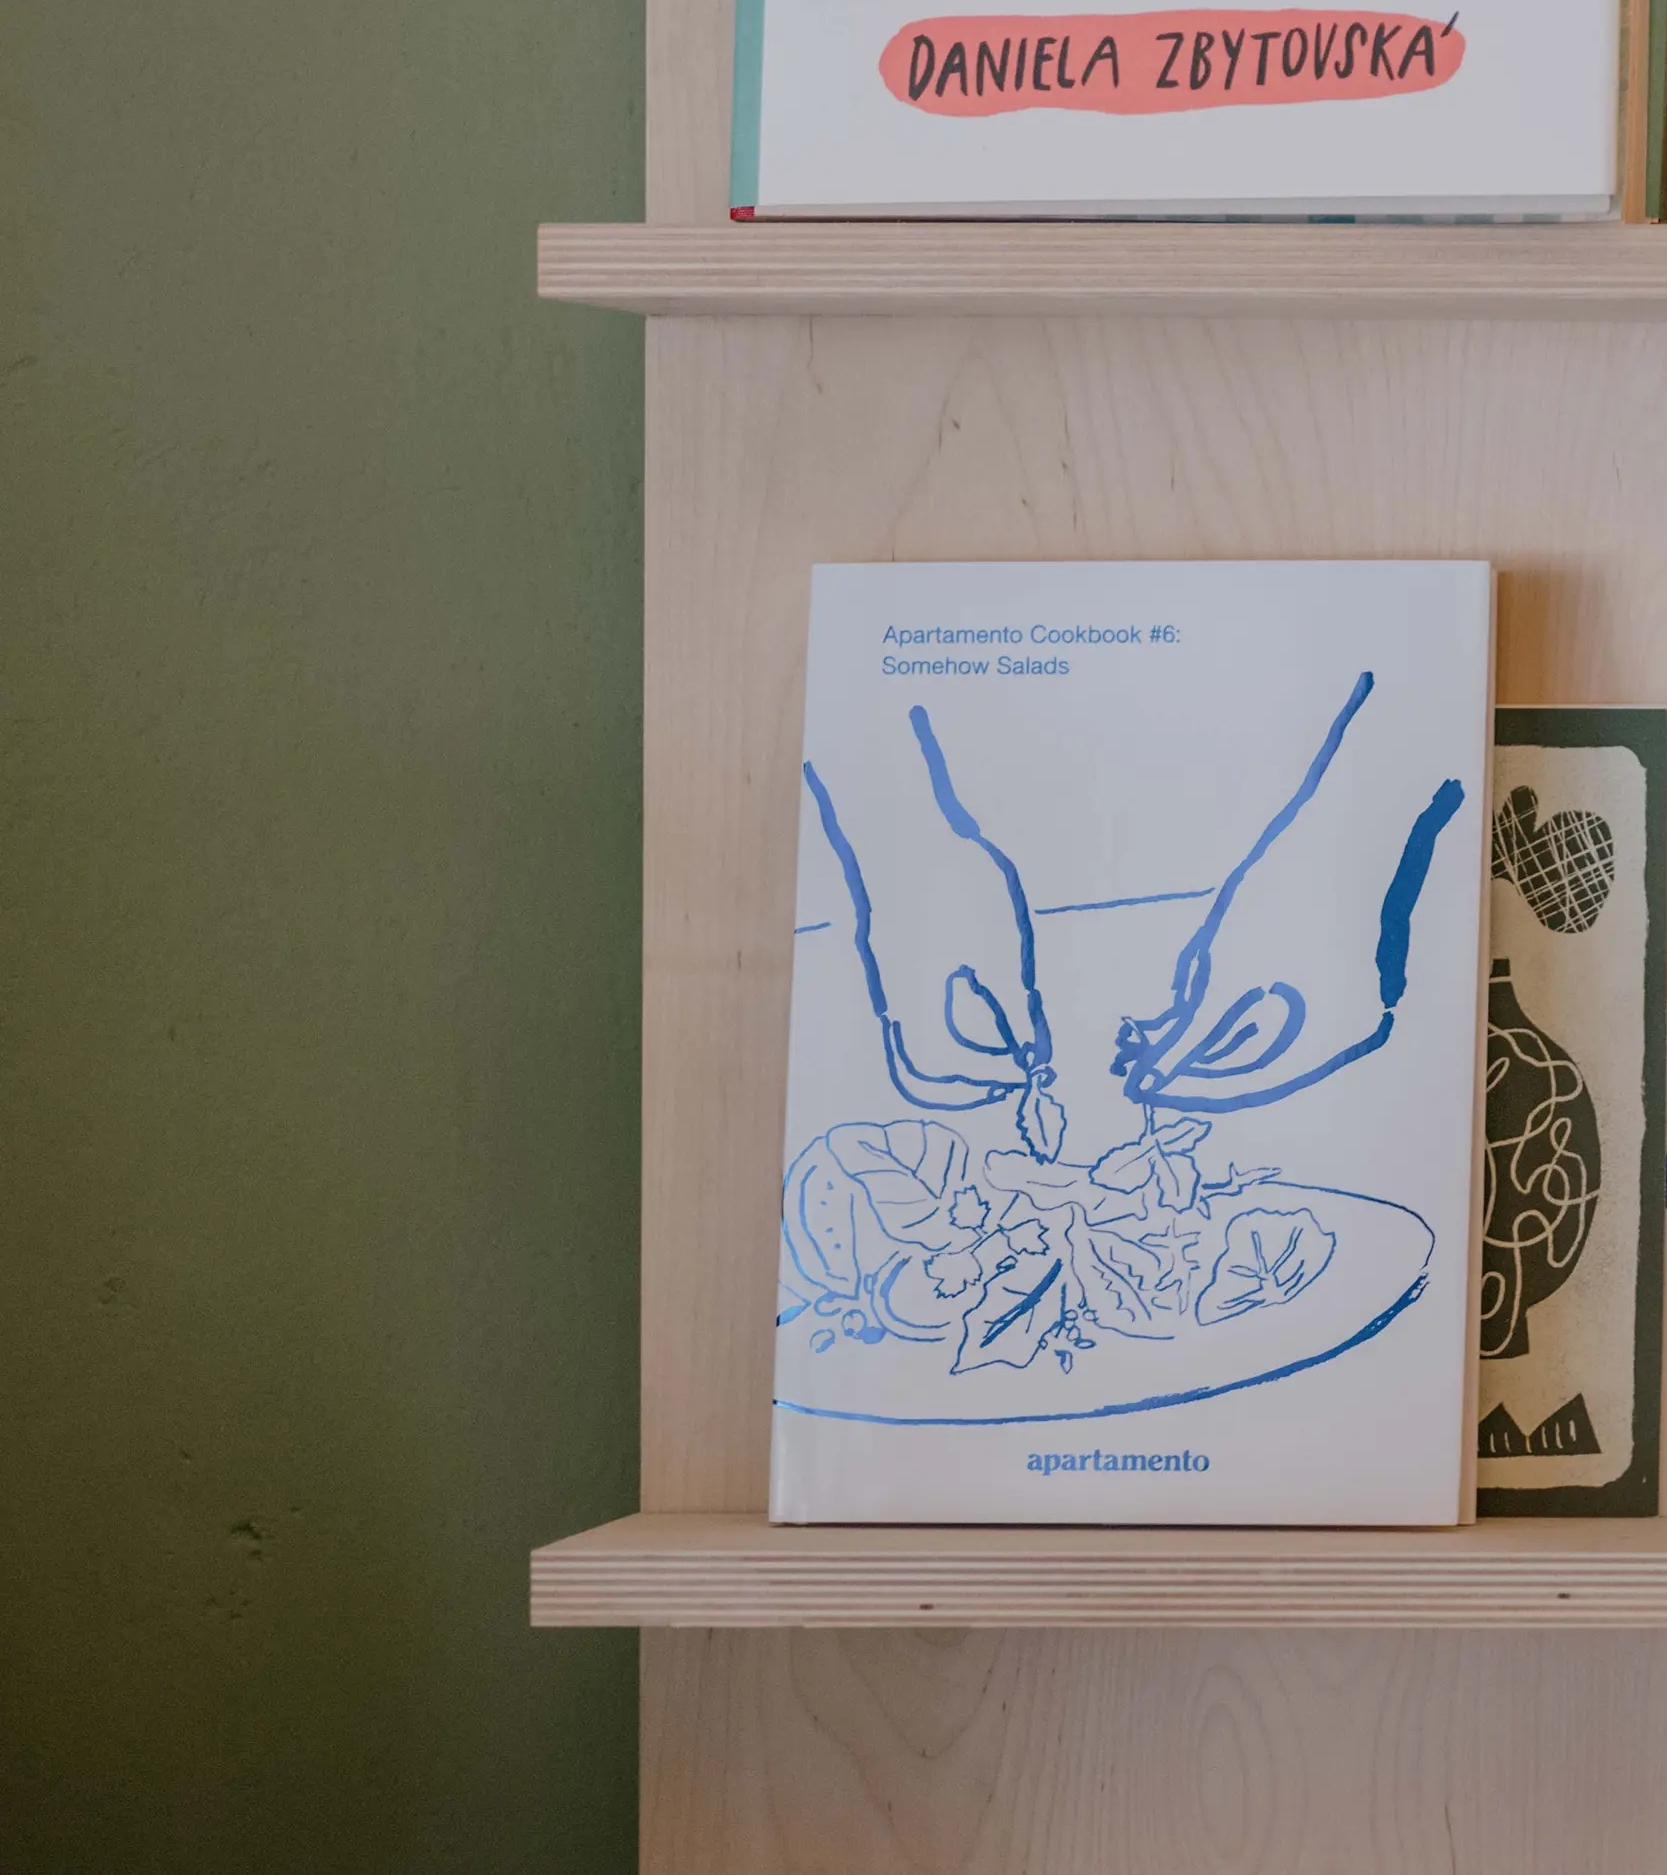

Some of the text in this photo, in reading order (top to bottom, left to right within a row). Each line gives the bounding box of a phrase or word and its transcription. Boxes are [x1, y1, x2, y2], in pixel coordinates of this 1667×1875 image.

[908, 11, 1460, 101] DANIELA ZBYTOVSKÁ
[882, 624, 1183, 648] Apartamento Cookbook #6:
[882, 655, 1069, 675] Somehow Salads
[1027, 1449, 1210, 1475] apartamento
